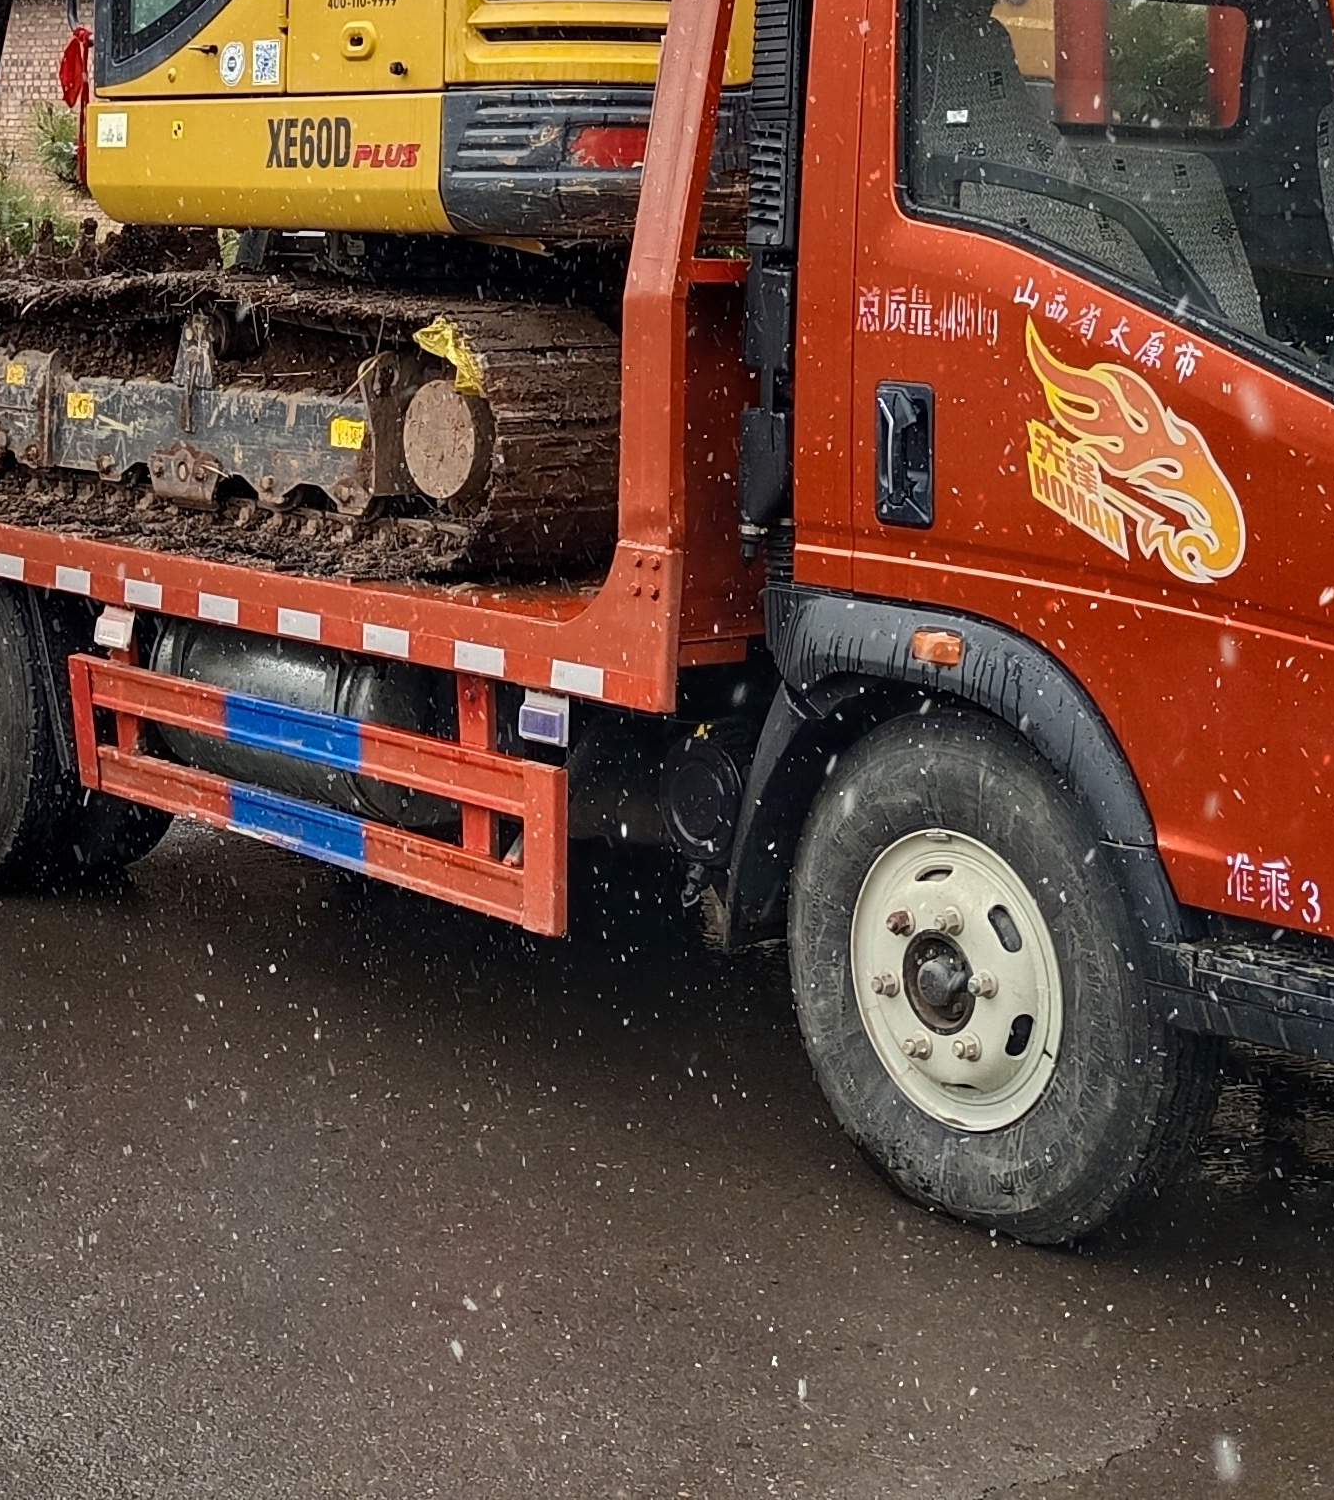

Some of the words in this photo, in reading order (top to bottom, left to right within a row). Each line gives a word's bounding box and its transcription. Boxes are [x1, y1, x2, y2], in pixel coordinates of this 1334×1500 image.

[266, 117, 351, 169] XE60D
[352, 143, 421, 169] PLUS
[1013, 277, 1204, 384] 山西省太原市
[1033, 427, 1100, 498] 先锋
[1033, 463, 1124, 552] HOMAN
